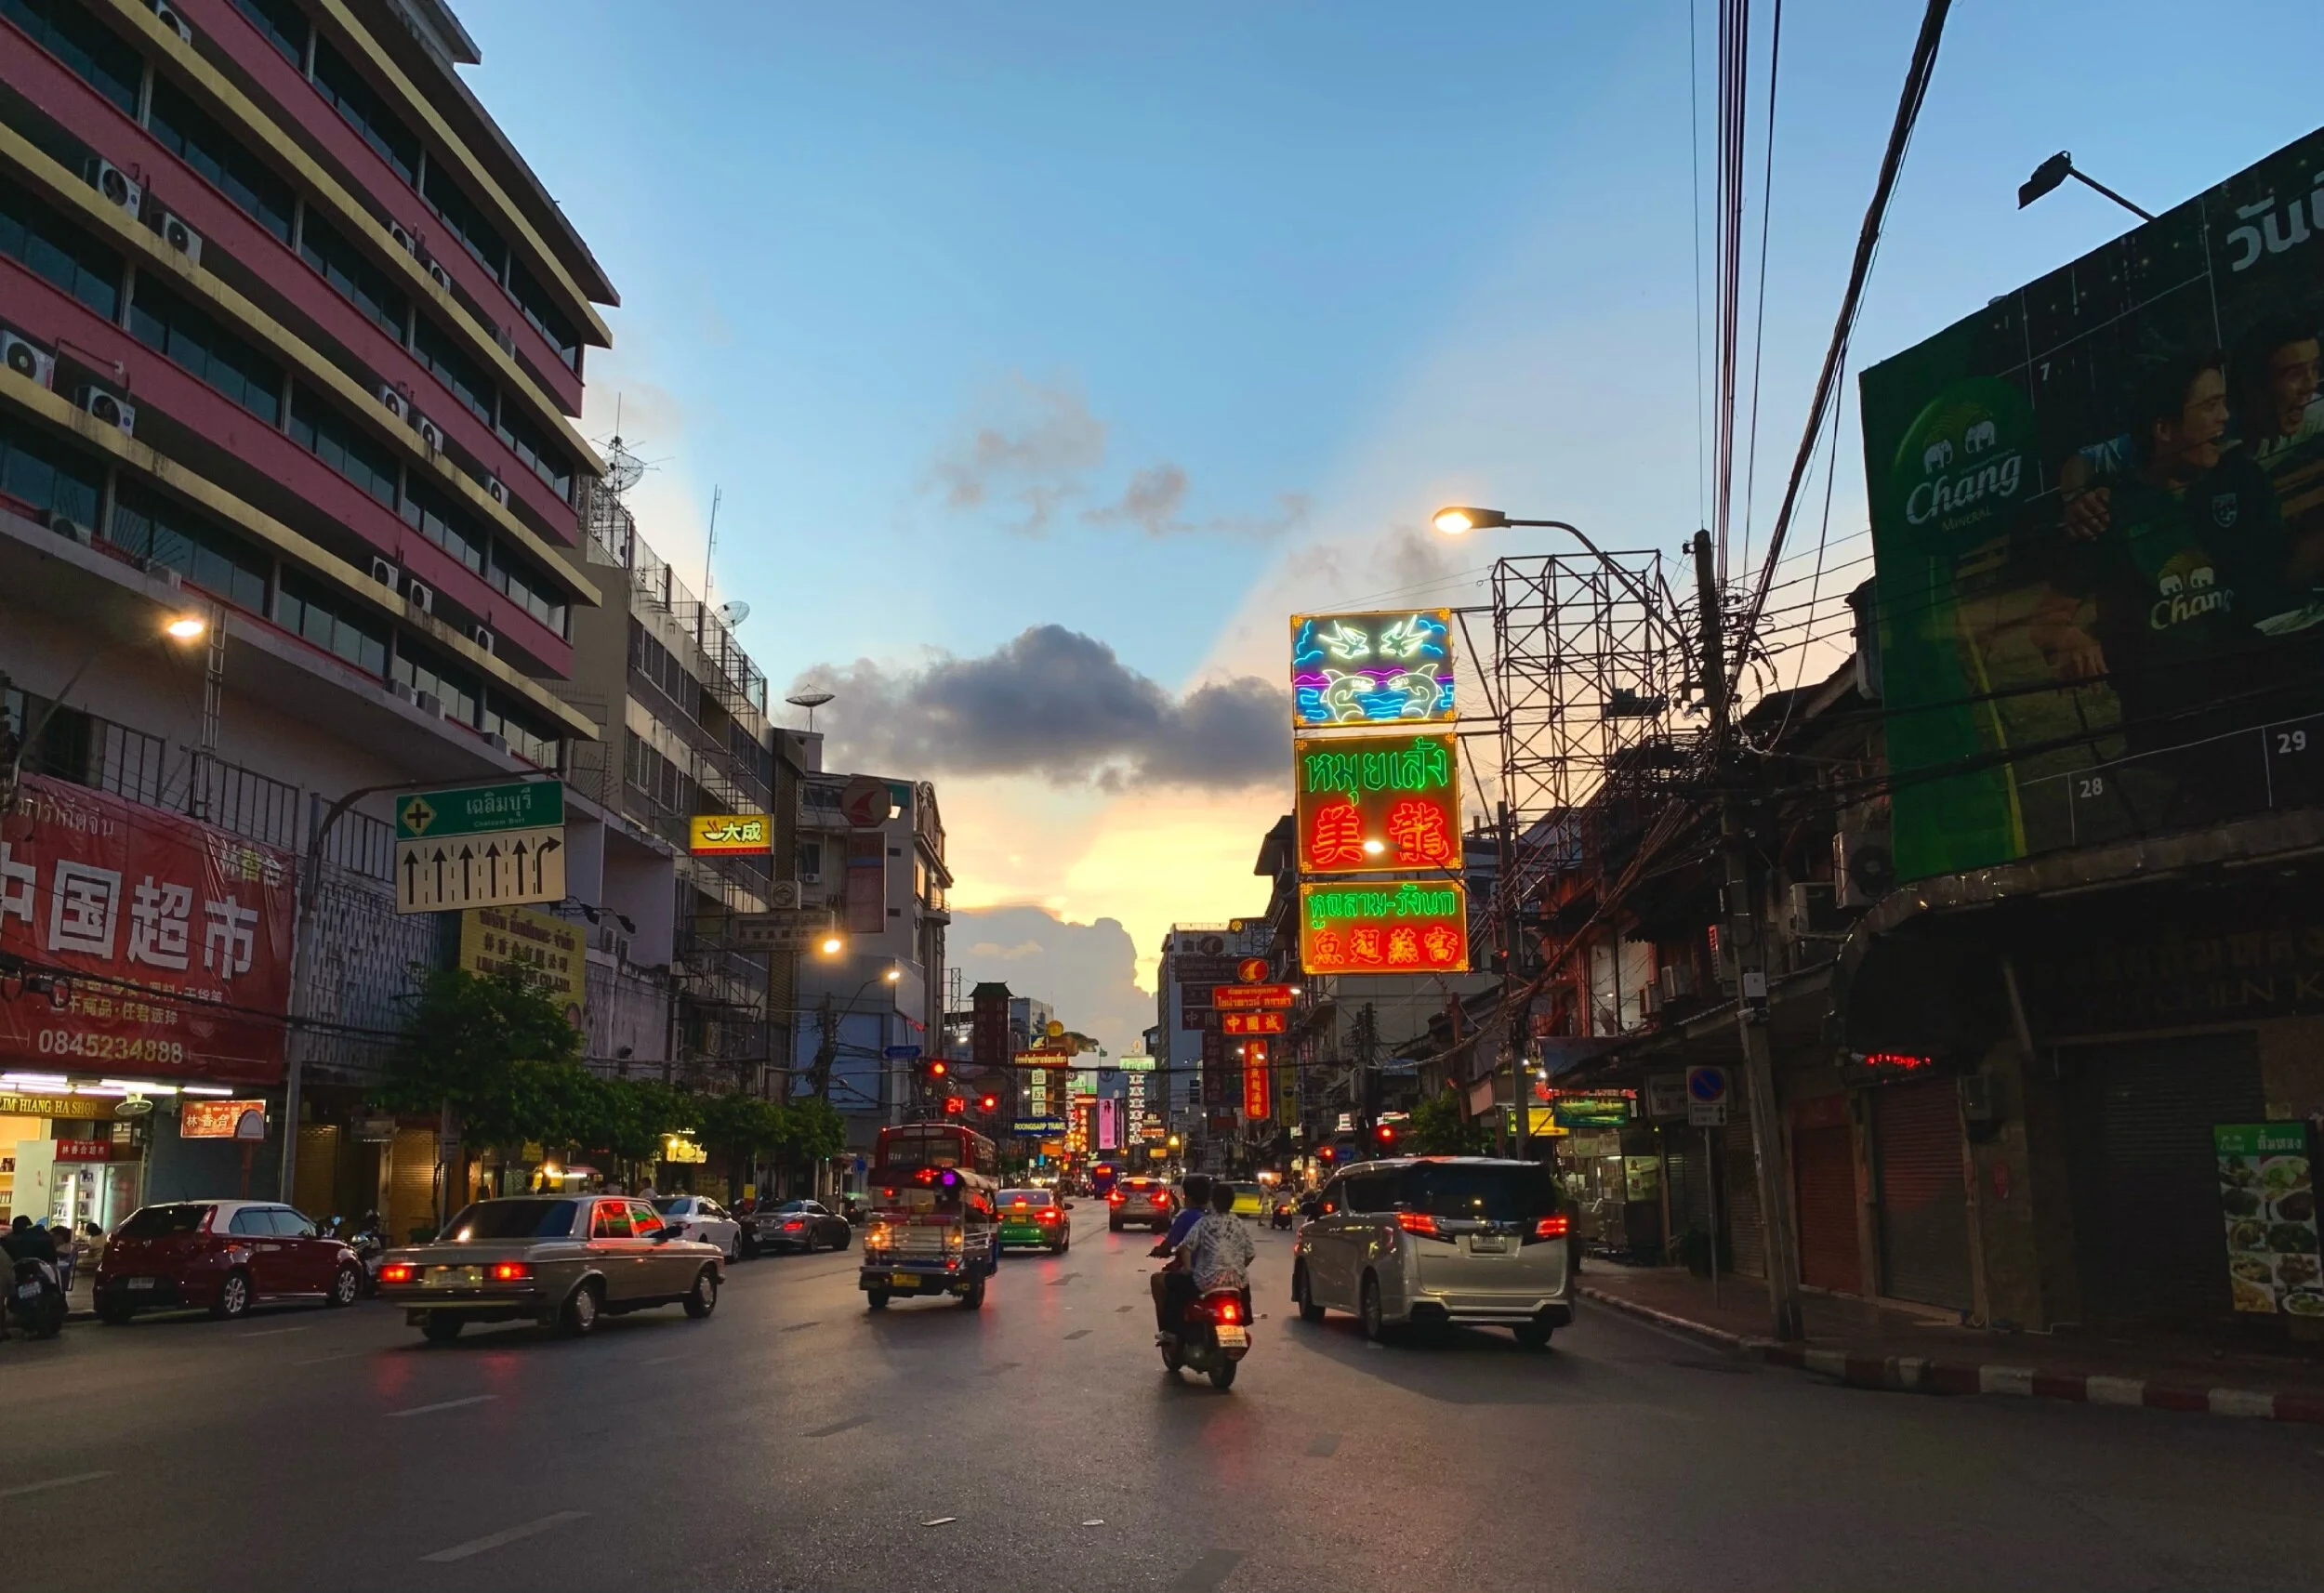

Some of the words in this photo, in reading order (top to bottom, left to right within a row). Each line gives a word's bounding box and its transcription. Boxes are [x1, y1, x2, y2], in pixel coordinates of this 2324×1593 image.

[2227, 171, 2324, 272] วัน
[1906, 454, 2022, 526] Chang
[2150, 587, 2235, 630] Chang
[2277, 730, 2306, 754] 29
[1304, 736, 1448, 807] หมุยเล้ง
[2080, 778, 2104, 798] 28
[467, 787, 532, 817] เฉลิมบุรี
[1308, 883, 1456, 930] หูฉลาม-รังนก
[38, 1030, 183, 1064] 0845234888
[20, 1099, 51, 1113] HIANG
[55, 1100, 69, 1114] HA
[948, 1098, 964, 1112] 24
